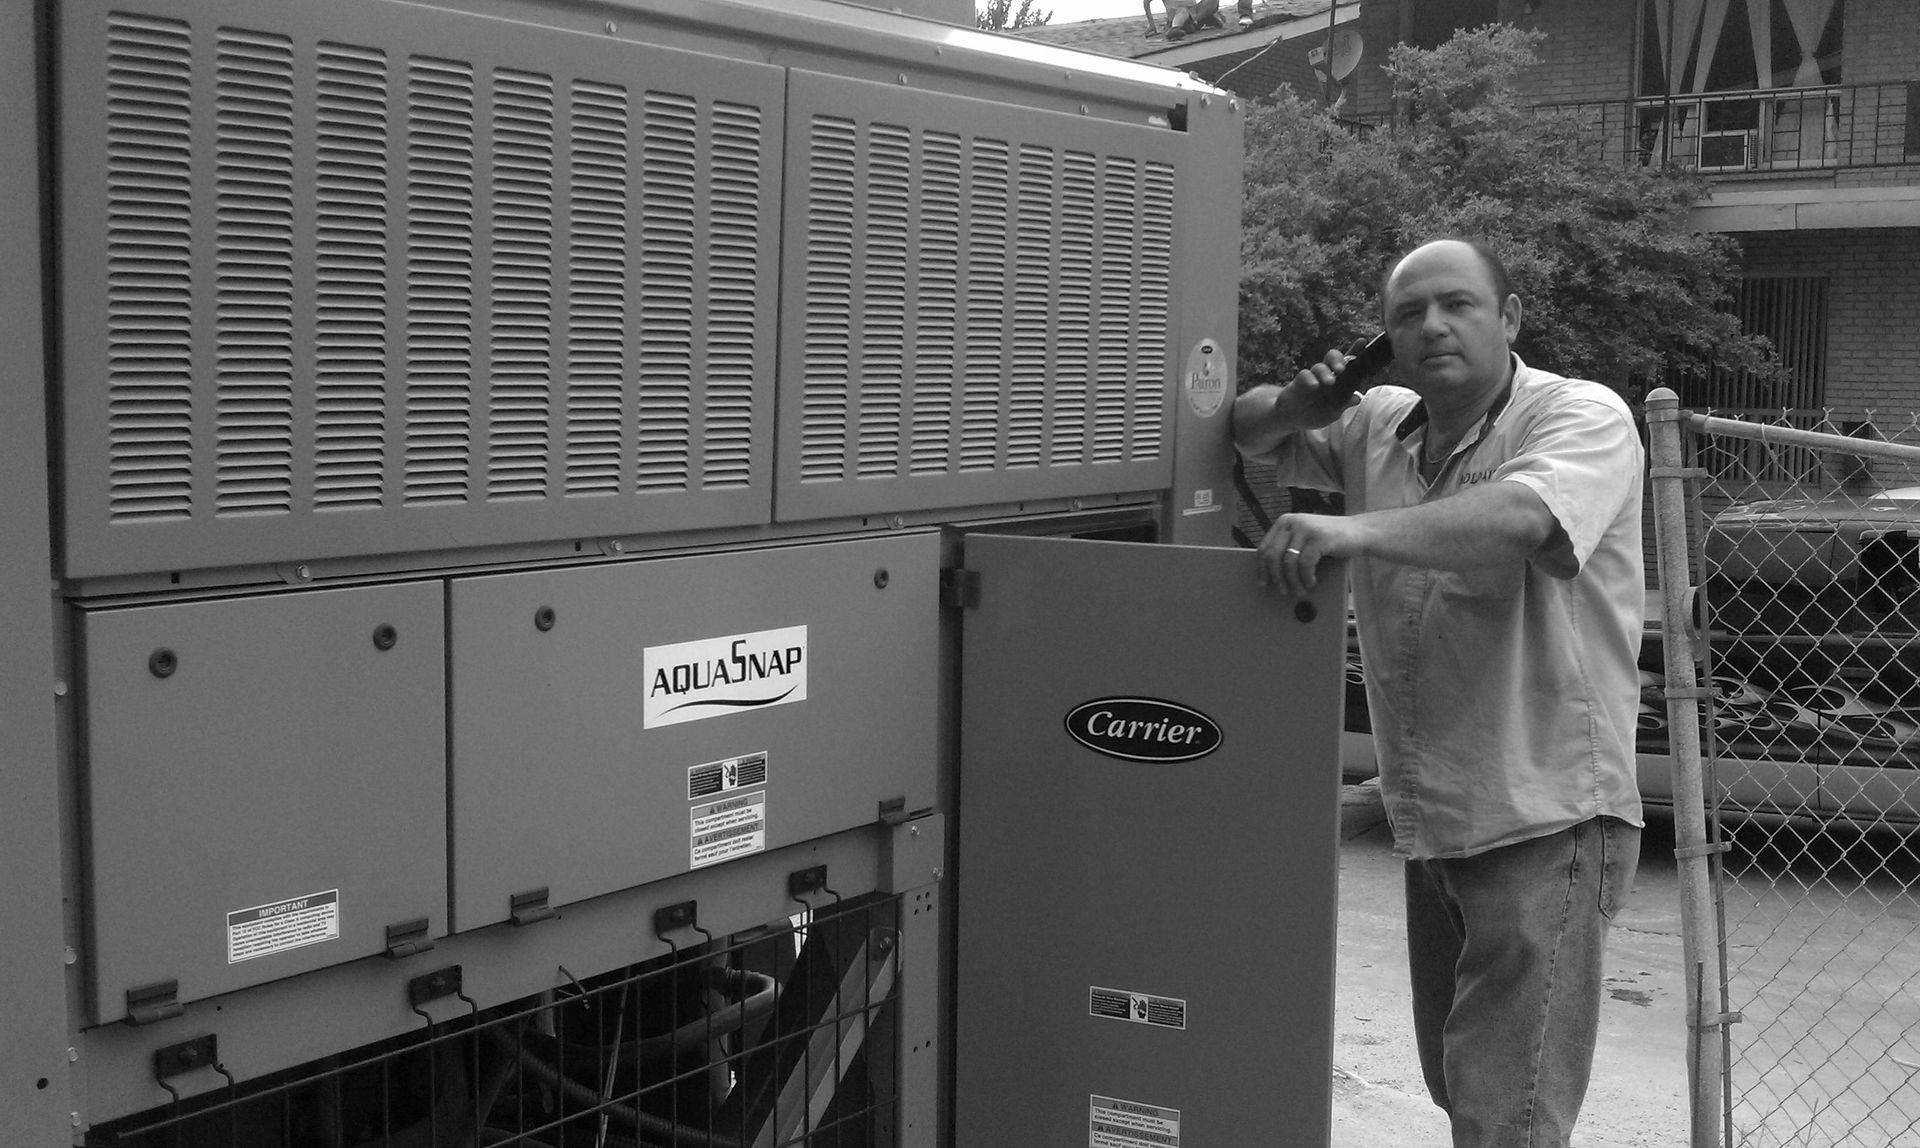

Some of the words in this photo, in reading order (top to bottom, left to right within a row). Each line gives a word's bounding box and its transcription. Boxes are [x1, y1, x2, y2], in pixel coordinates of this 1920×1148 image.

[1086, 711, 1202, 744] Carrier
[717, 798, 748, 812] WARNING
[259, 900, 308, 917] IMPORTANT
[1121, 1104, 1159, 1116] WARNING
